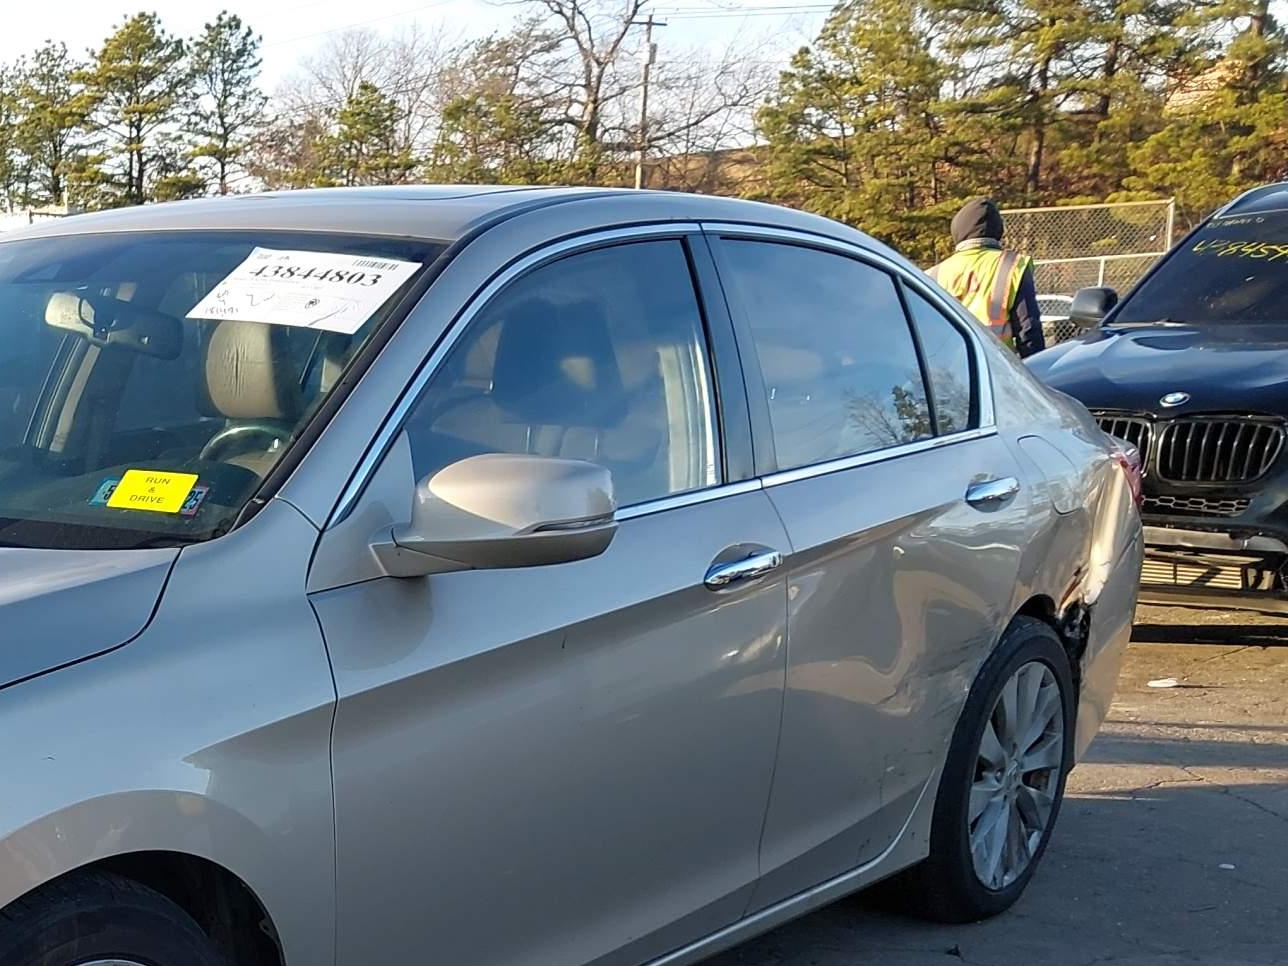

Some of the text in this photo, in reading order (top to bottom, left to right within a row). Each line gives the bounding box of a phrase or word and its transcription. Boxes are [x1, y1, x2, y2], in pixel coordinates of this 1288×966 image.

[248, 264, 382, 288] 43844803
[145, 476, 172, 485] RUN
[147, 486, 157, 494] &
[129, 494, 167, 504] DRIVE
